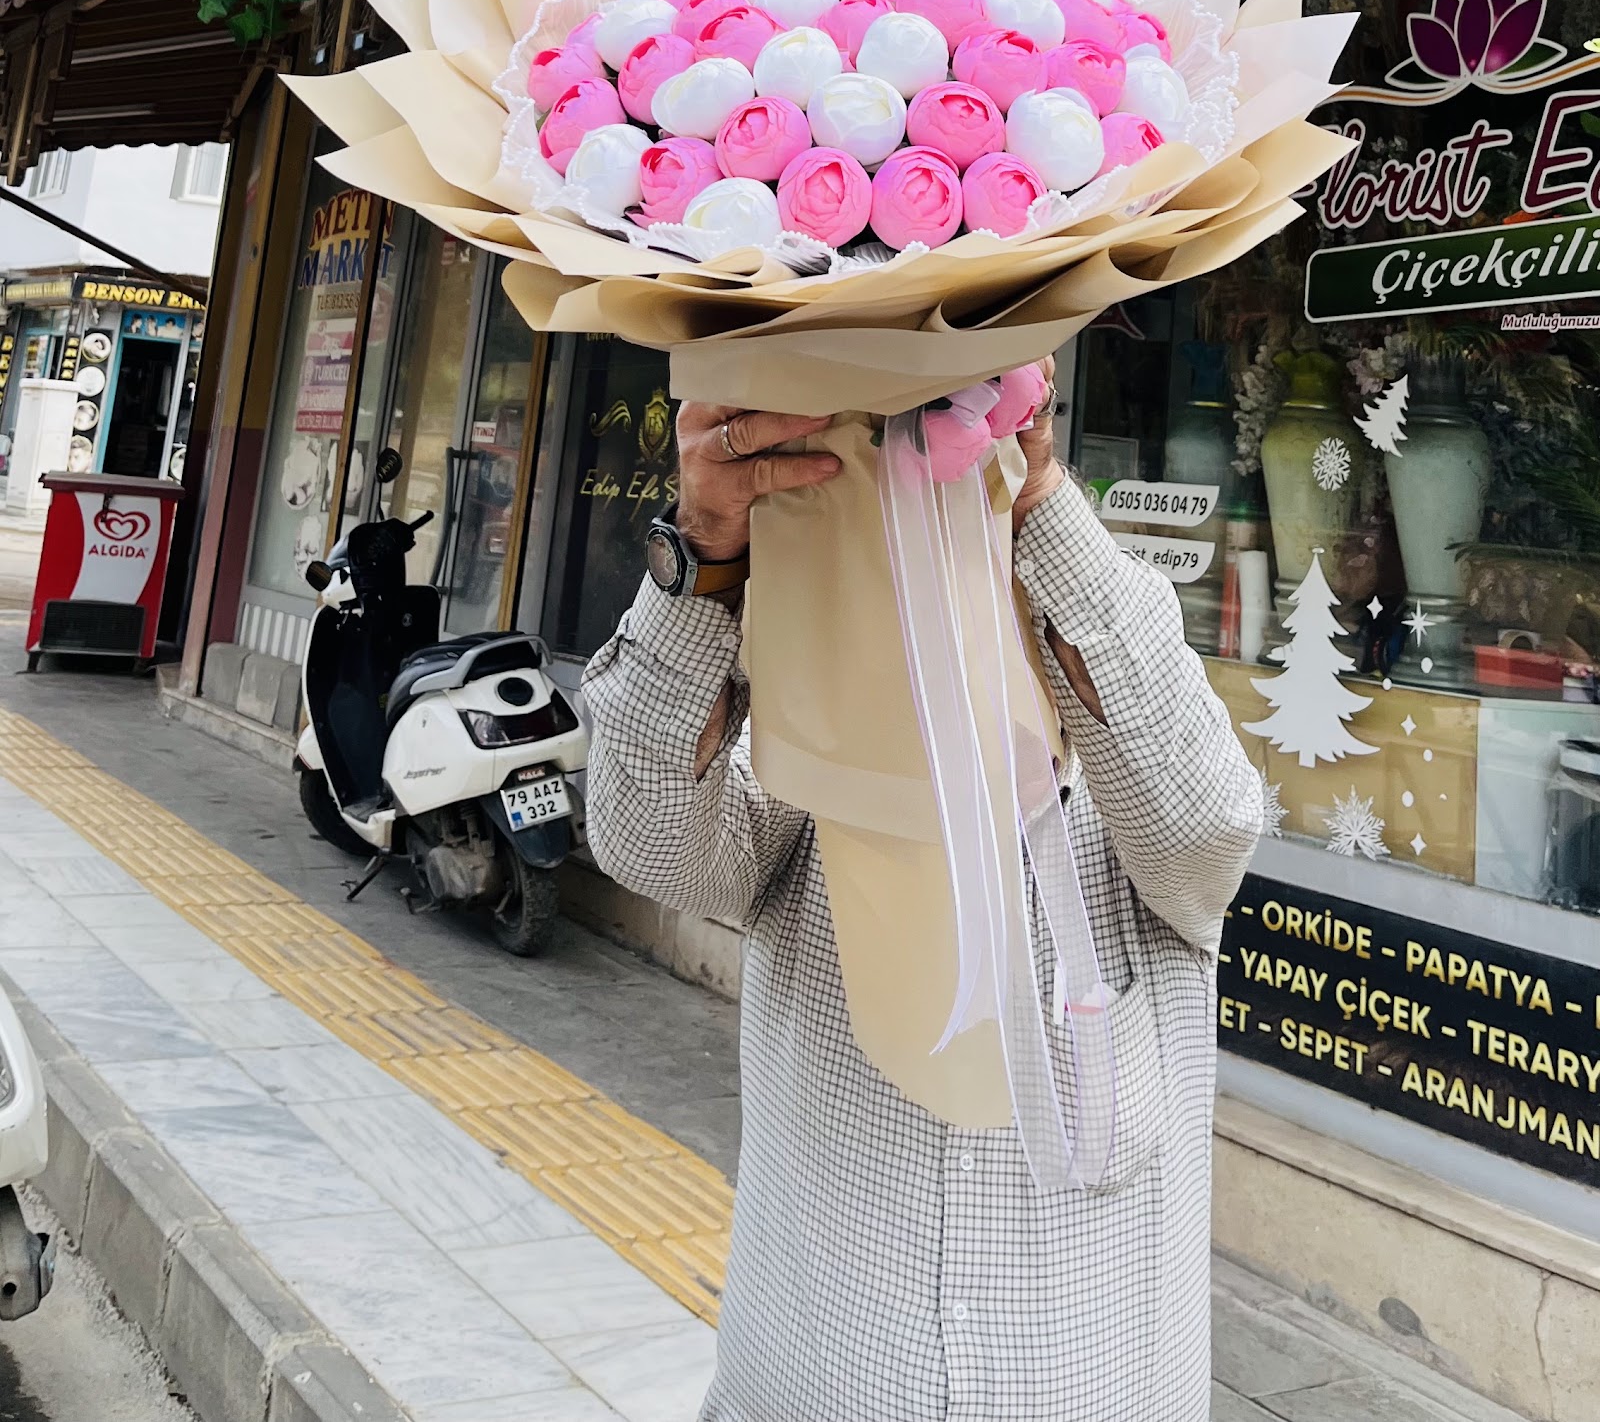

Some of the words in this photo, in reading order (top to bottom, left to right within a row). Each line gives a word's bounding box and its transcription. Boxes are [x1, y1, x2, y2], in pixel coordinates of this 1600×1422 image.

[1294, 118, 1512, 229] lorist
[1520, 89, 1600, 214] E
[299, 237, 395, 288] MARKT
[1371, 227, 1600, 305] Çiçekçili
[82, 281, 165, 306] BENSON
[580, 469, 621, 512] Edip
[626, 471, 660, 522] Efe
[1109, 490, 1142, 510] 0505
[1144, 492, 1168, 513] 036
[1171, 495, 1188, 515] 04
[1190, 496, 1208, 516] 79
[88, 543, 146, 559] ALGIDA
[507, 790, 528, 807] 79
[533, 780, 562, 799] AAZ
[527, 800, 557, 819] 332
[1261, 900, 1373, 960] ORKİDE
[1405, 939, 1554, 1016] PAPATYA
[1239, 946, 1329, 1002] YAPAY
[1334, 976, 1432, 1039] ÇİÇEK
[1466, 1019, 1600, 1093] TERARY
[1279, 1017, 1370, 1076] SEPET
[1400, 1062, 1600, 1161] ARANJMAN
